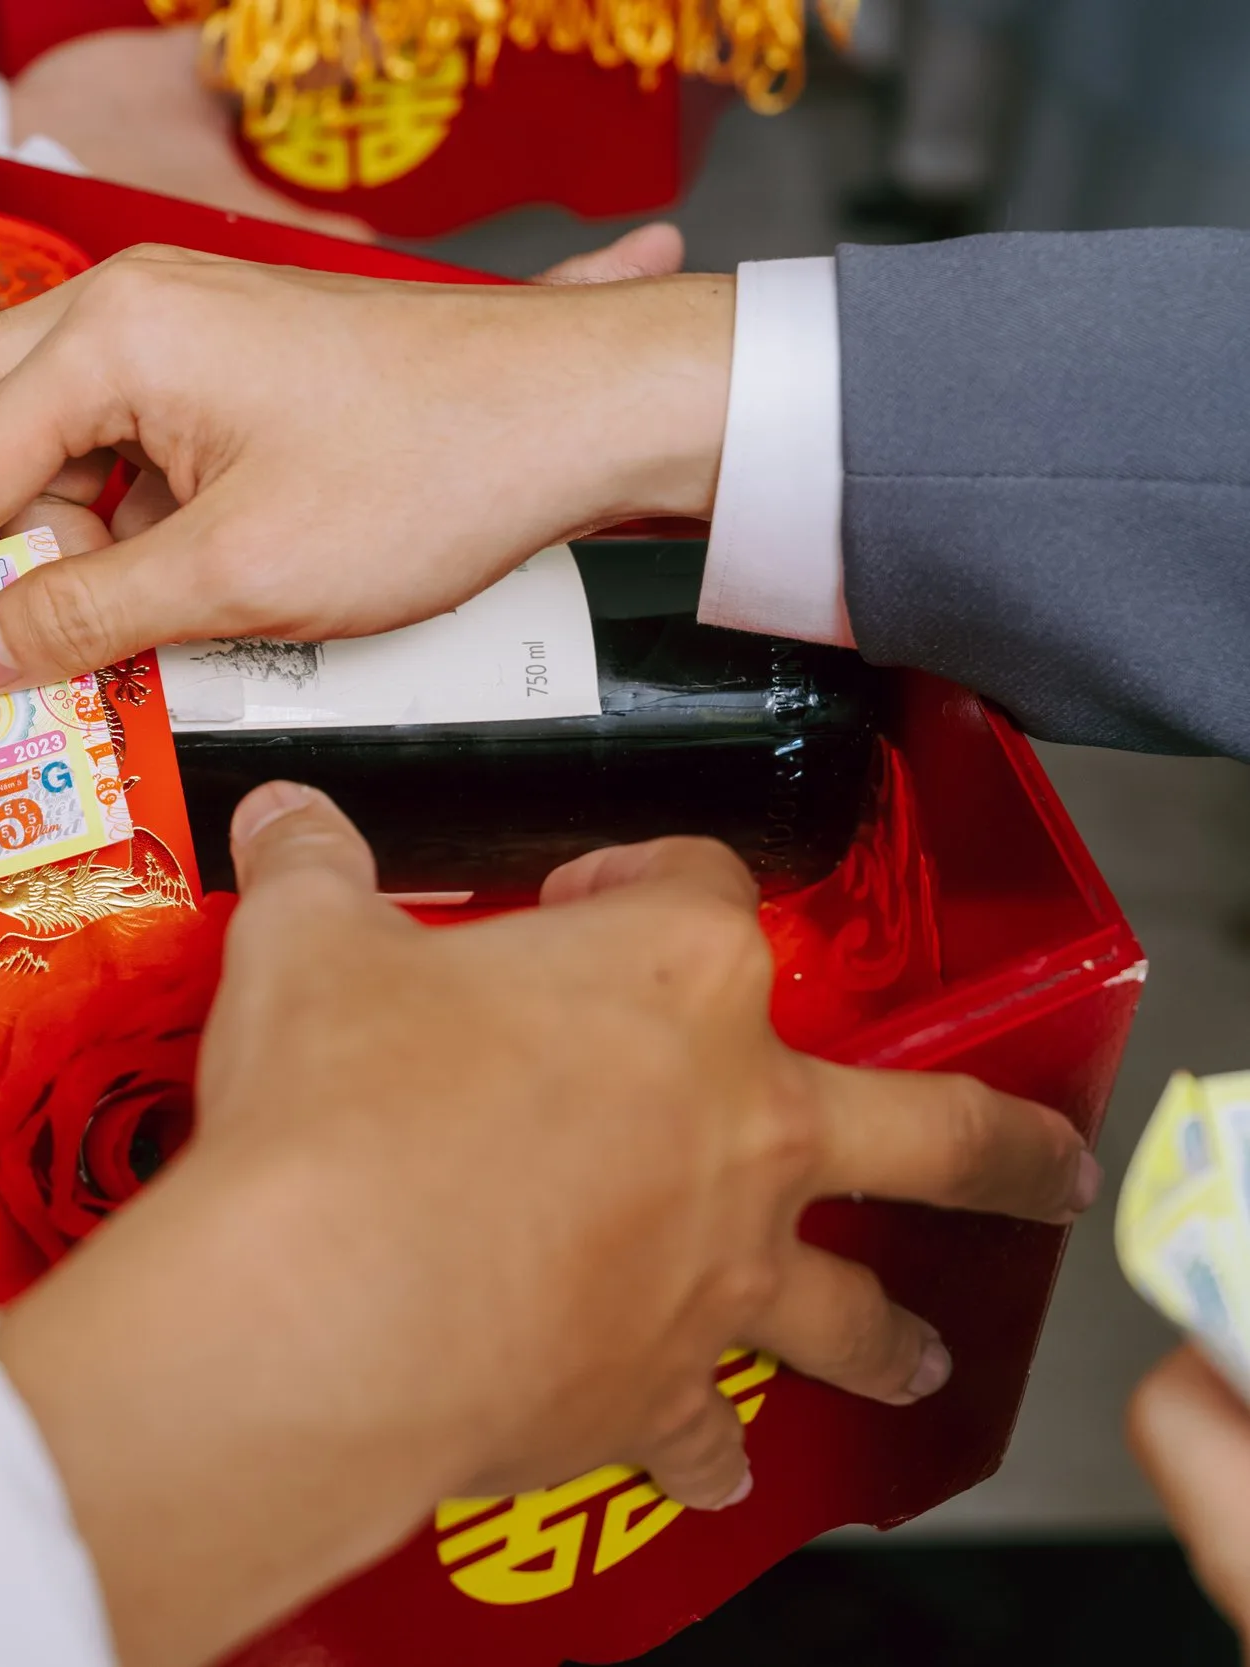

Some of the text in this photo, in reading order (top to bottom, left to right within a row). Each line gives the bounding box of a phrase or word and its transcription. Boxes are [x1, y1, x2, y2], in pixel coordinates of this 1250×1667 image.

[522, 641, 548, 697] 750 ml
[15, 735, 65, 763] 2023
[42, 761, 73, 793] G
